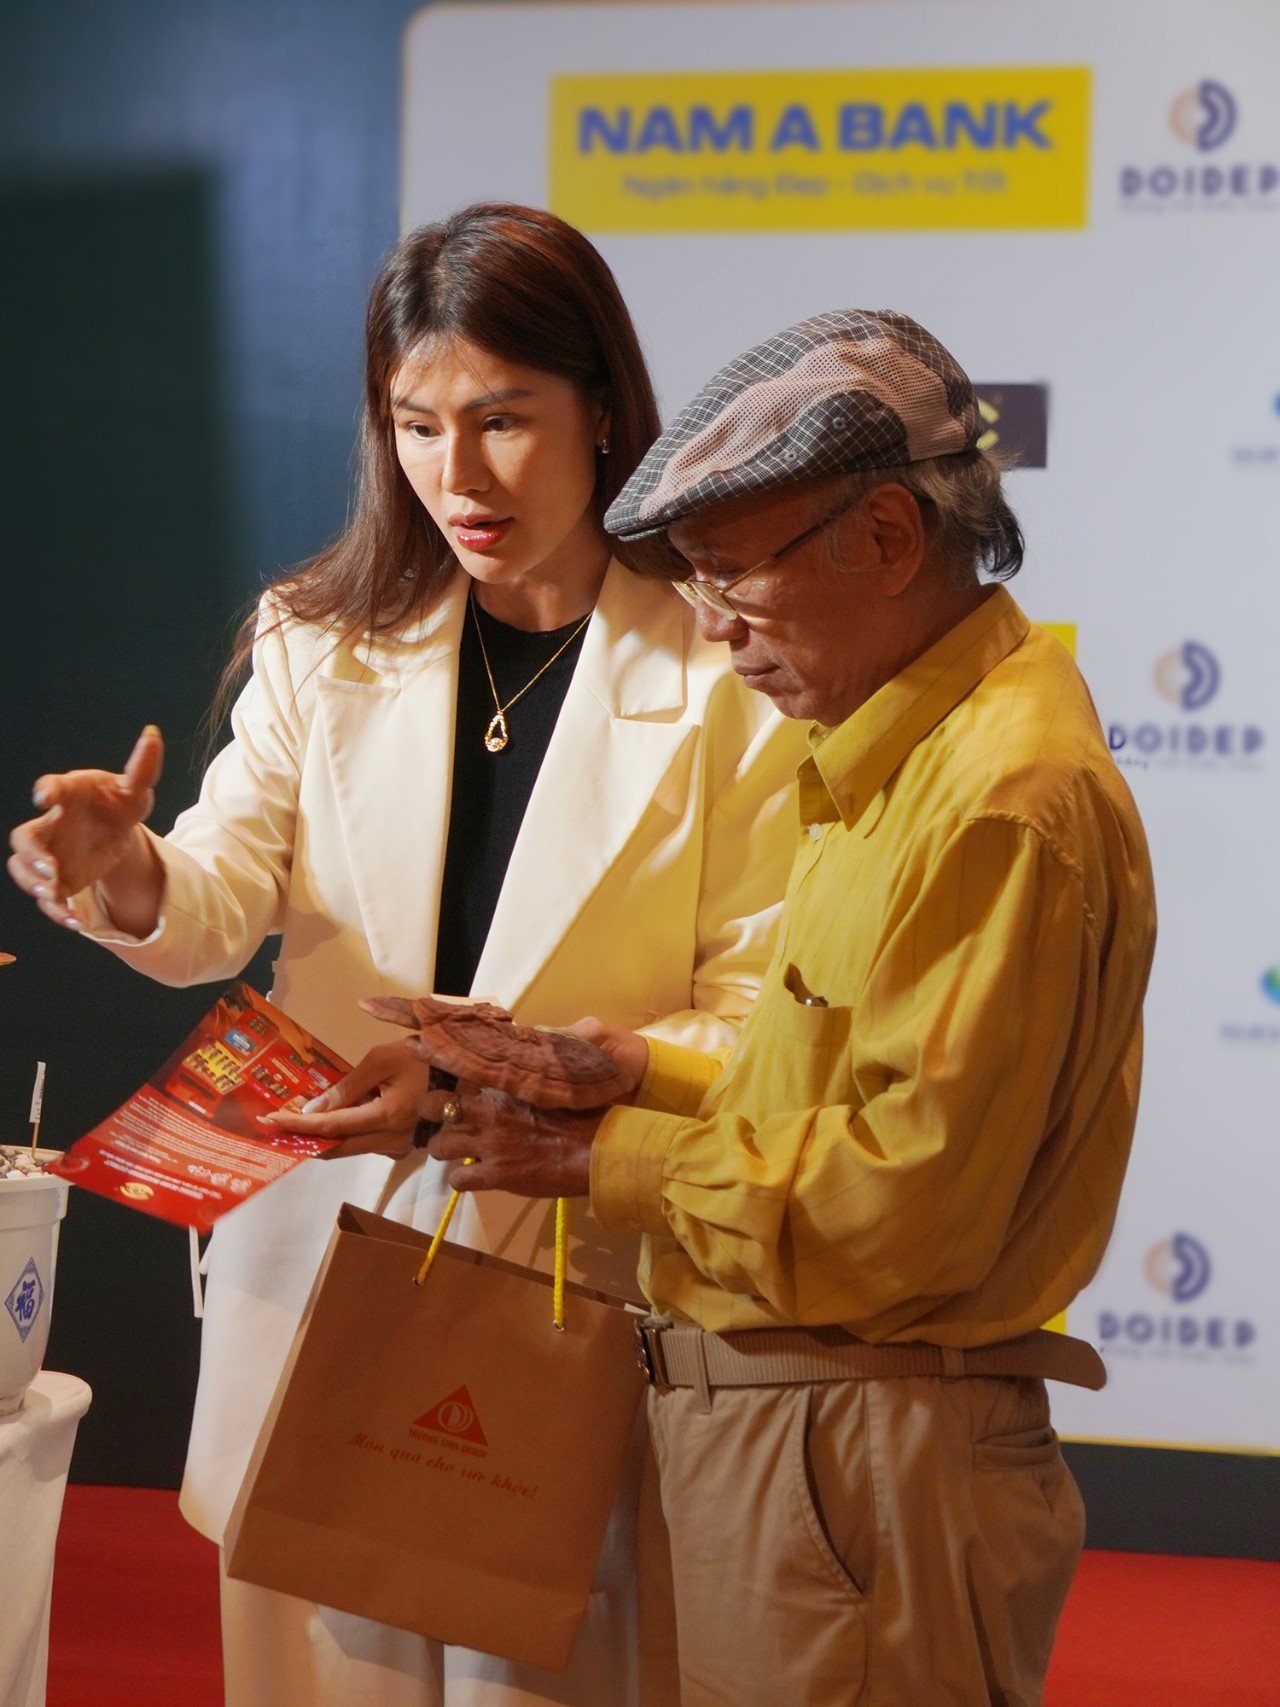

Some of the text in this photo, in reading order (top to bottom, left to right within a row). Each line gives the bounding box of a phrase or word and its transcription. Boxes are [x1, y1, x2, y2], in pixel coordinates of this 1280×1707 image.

[578, 100, 1054, 156] NAM A BANK
[15, 1279, 37, 1322] 福
